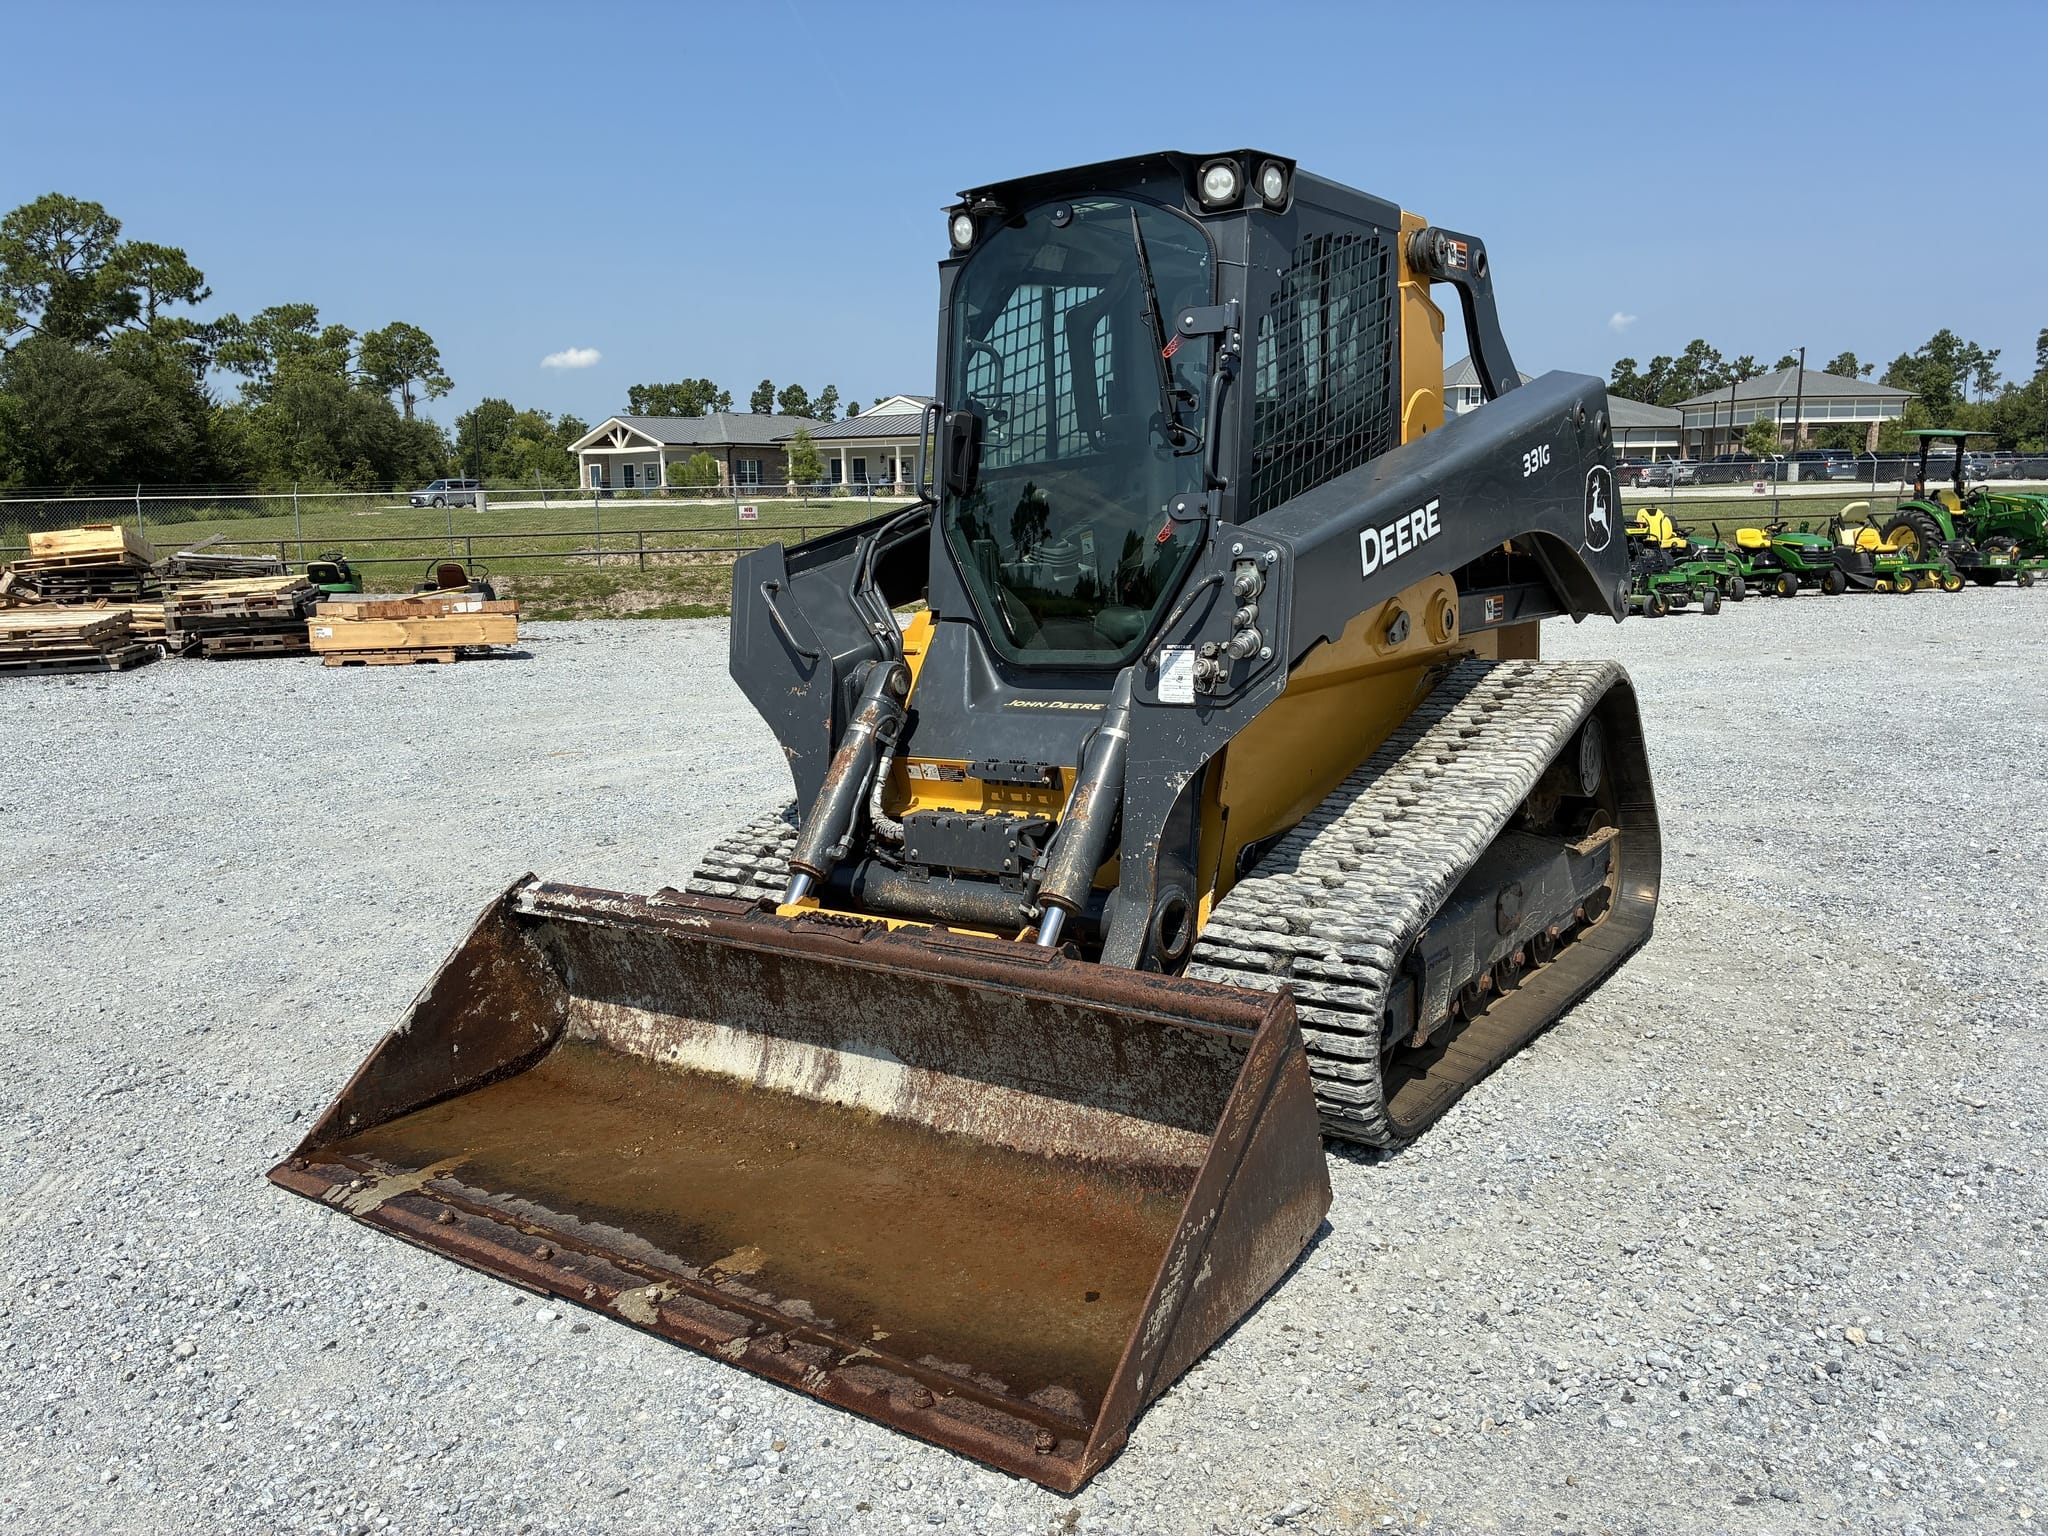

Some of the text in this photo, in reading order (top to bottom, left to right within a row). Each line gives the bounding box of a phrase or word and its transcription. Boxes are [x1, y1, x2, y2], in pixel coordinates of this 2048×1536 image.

[1522, 443, 1551, 478] 331G
[1359, 498, 1441, 577] DEERE
[1003, 699, 1106, 710] JOHN DEERE
